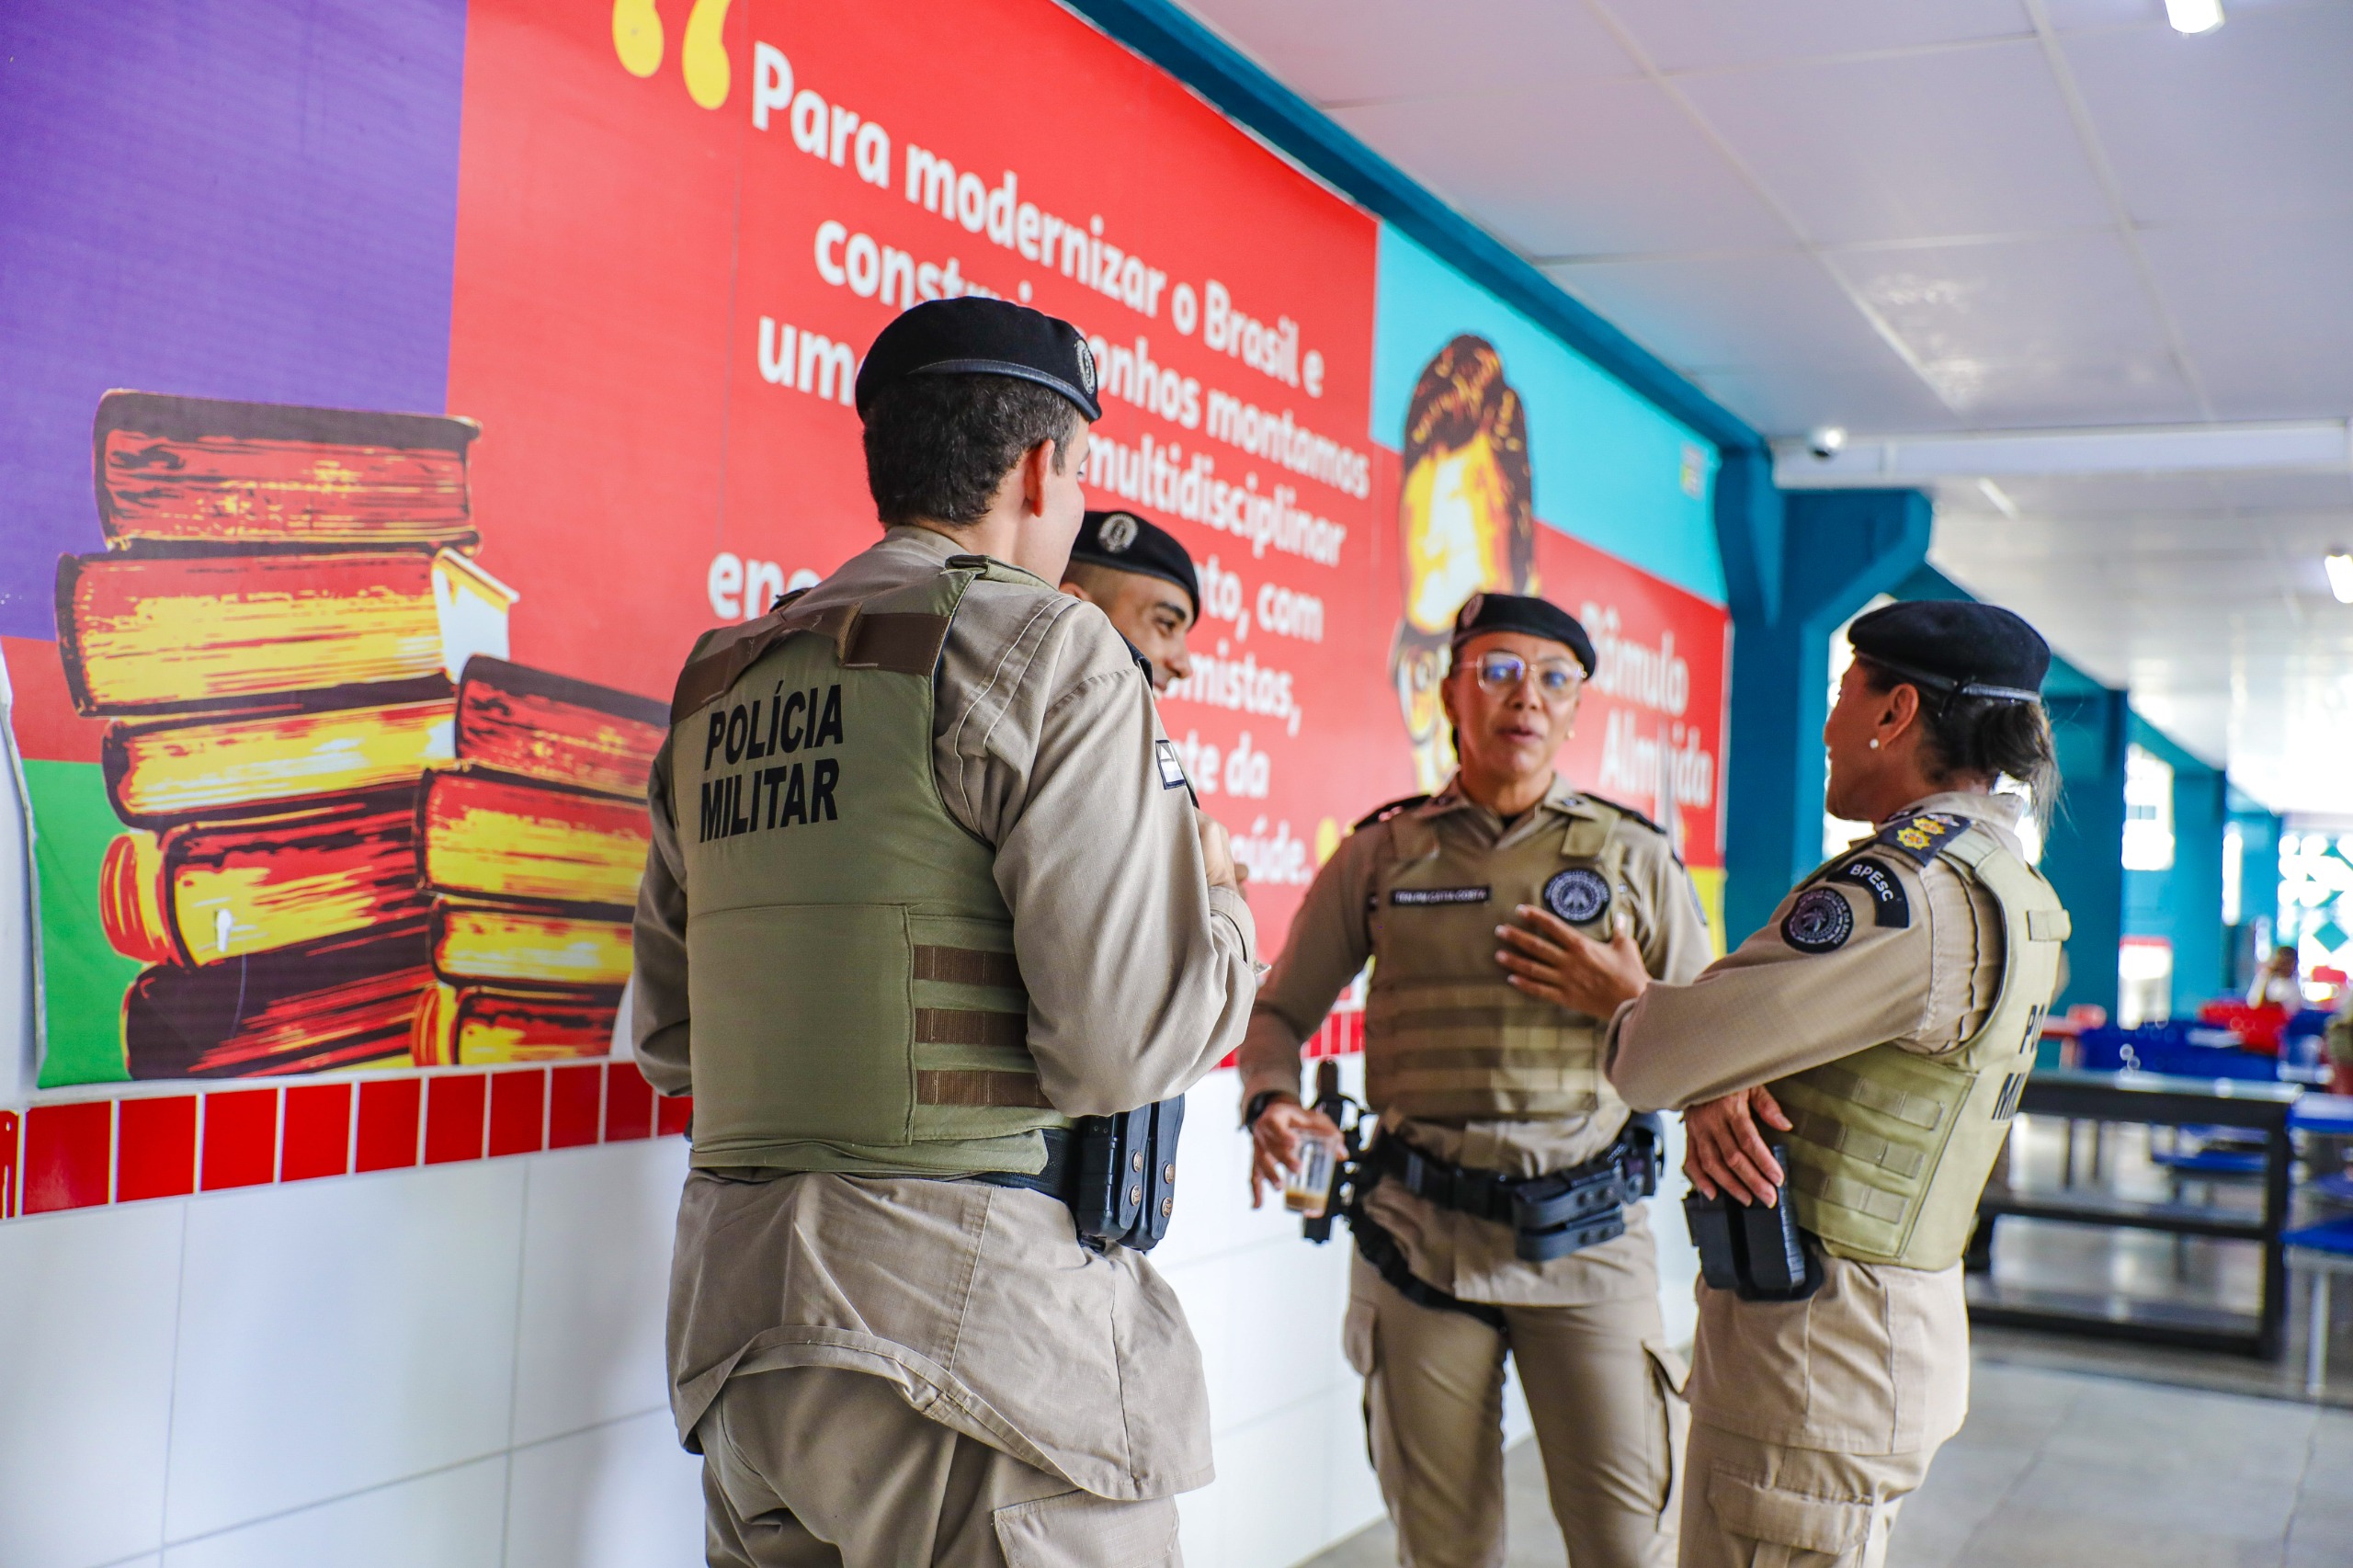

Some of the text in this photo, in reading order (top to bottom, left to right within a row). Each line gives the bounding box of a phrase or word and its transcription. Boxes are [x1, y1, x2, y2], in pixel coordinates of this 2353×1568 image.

[752, 40, 1324, 399] Para modernizar o Brasil e
[813, 220, 1370, 500] const onhos montamos
[757, 315, 1347, 568] um multidisciplinar
[1256, 583, 1324, 643] com
[704, 680, 844, 771] POLÍCIA
[1224, 730, 1271, 800] da
[699, 757, 840, 844] MILITAR
[1230, 813, 1314, 886] aúde.
[1849, 863, 1894, 903] BPESC
